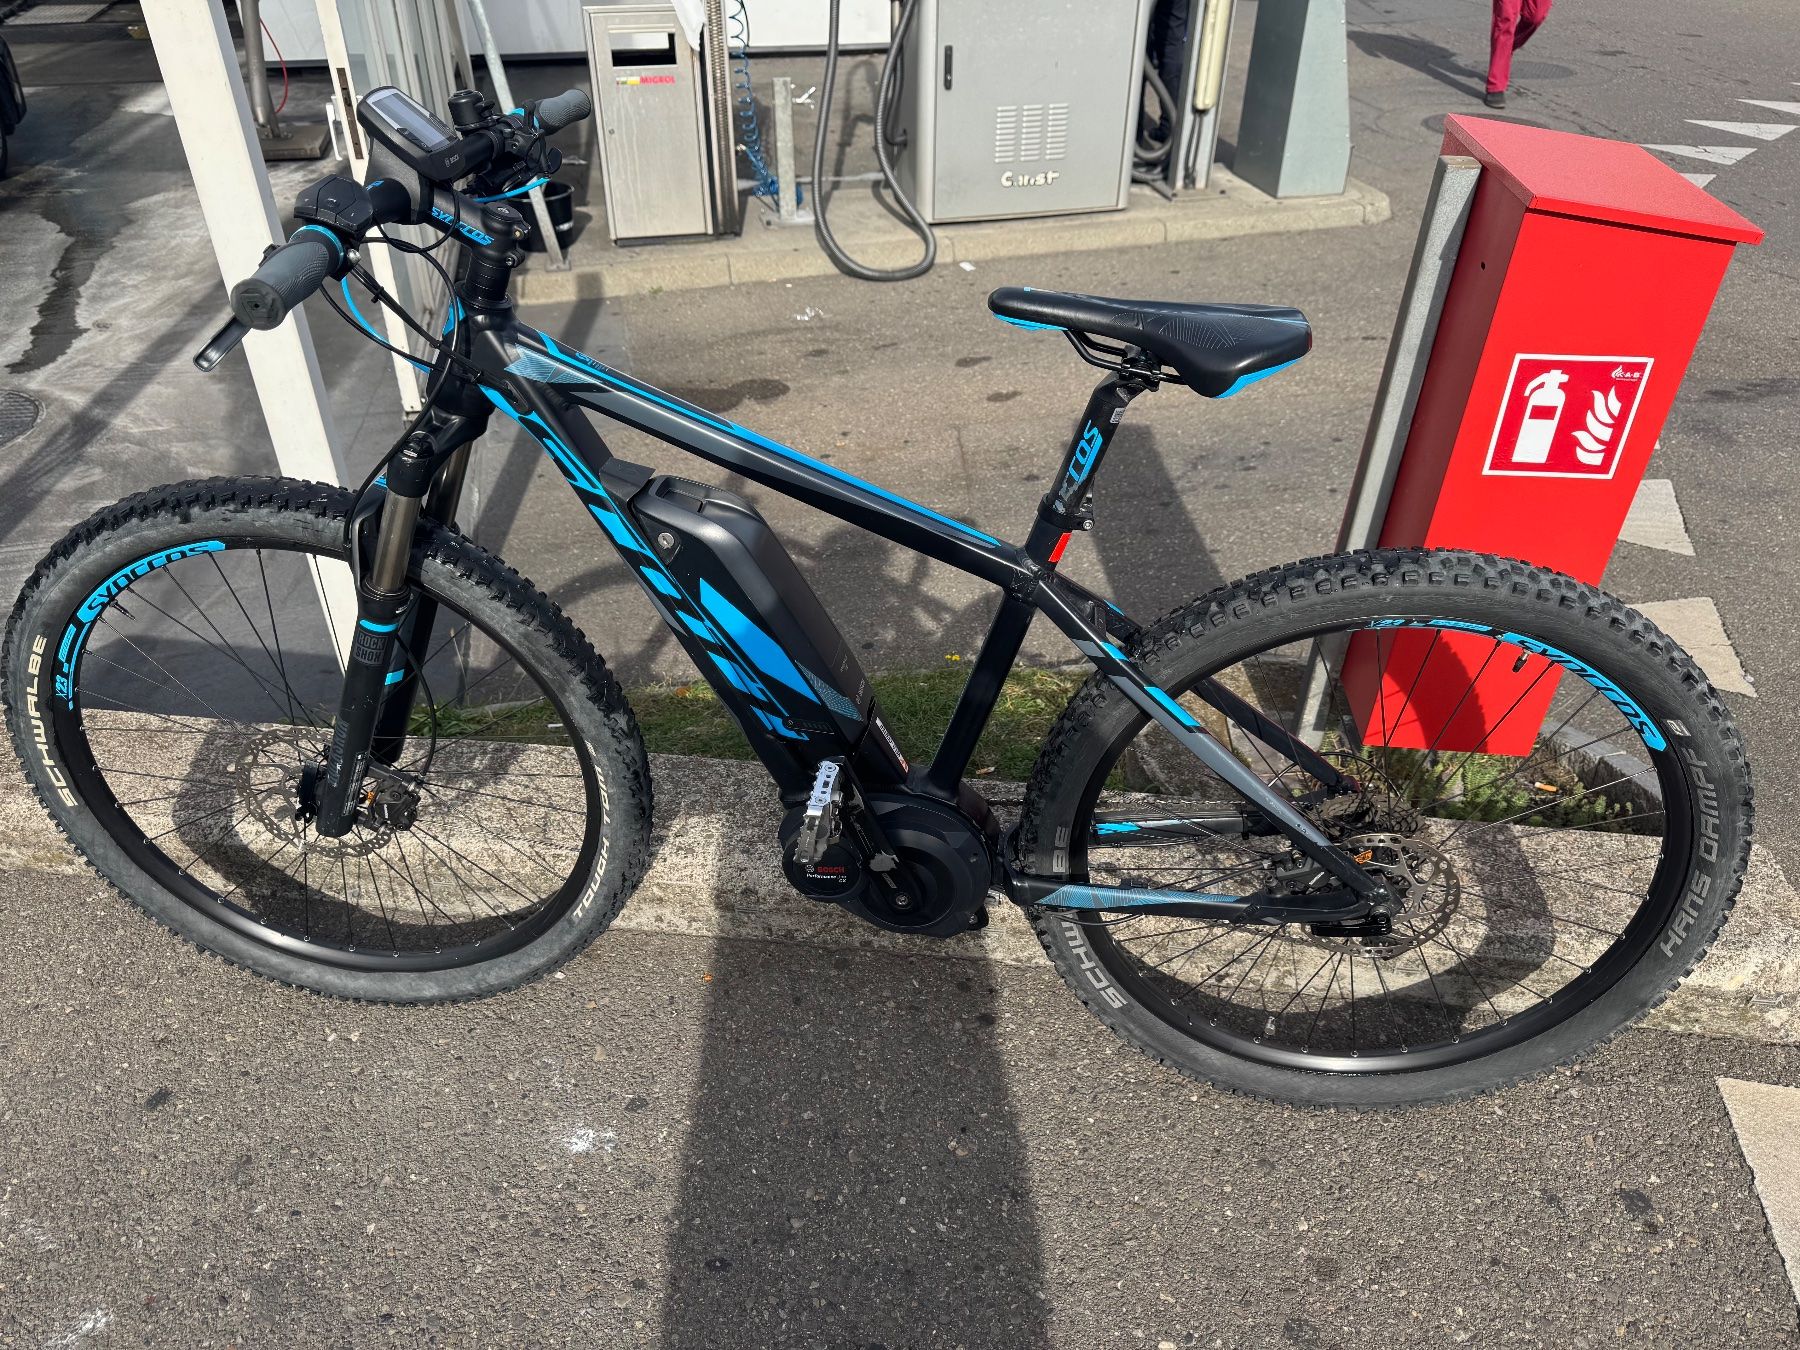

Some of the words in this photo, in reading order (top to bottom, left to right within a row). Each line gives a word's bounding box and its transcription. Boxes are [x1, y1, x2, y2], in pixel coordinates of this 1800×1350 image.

[87, 544, 210, 614] SYNCROS
[358, 631, 386, 650] ROCK
[26, 634, 79, 807] SCHWALBE
[573, 836, 611, 919] TOUGH
[594, 764, 612, 825] TOM
[1681, 747, 1720, 864] DAMPF
[1052, 825, 1129, 1010] SCHWBE
[1659, 869, 1712, 959] HANS
